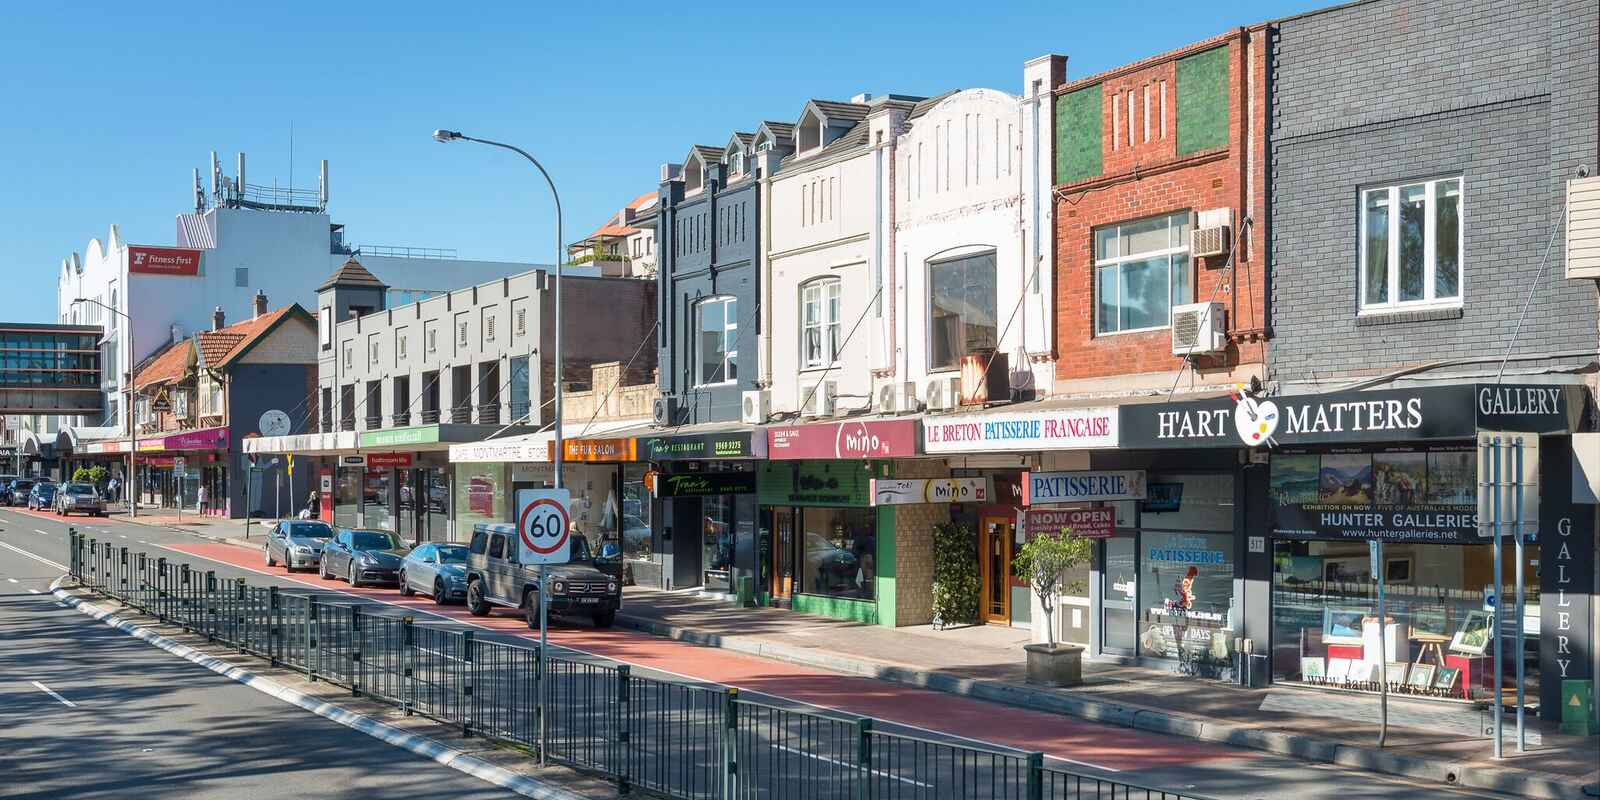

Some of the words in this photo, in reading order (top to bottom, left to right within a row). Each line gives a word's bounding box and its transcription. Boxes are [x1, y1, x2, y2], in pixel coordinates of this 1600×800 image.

[1479, 386, 1561, 416] GALLERY
[1158, 409, 1230, 439] H'ART
[1285, 397, 1423, 435] MATTERS
[928, 425, 940, 443] LE
[943, 422, 982, 442] BRETON
[985, 419, 1041, 440] PATISSERIE
[846, 429, 880, 452] mino
[473, 446, 521, 459] MONTMARTRE
[569, 445, 578, 456] THE
[580, 445, 592, 456] FUR
[594, 444, 615, 455] SALON
[935, 482, 970, 498] mino
[1033, 475, 1128, 499] PATISSERIE
[1302, 503, 1340, 512] EXHIBITION
[1354, 503, 1372, 511] NOW
[530, 513, 561, 538] 60
[1031, 512, 1068, 525] NOW
[1071, 510, 1112, 523] OPEN
[1320, 512, 1384, 528] HUNTER
[1342, 529, 1457, 542] www.huntergalleries.net
[1149, 549, 1225, 564] PATISSERIE
[1557, 518, 1571, 678] GALLERY
[1191, 627, 1211, 641] DAYS
